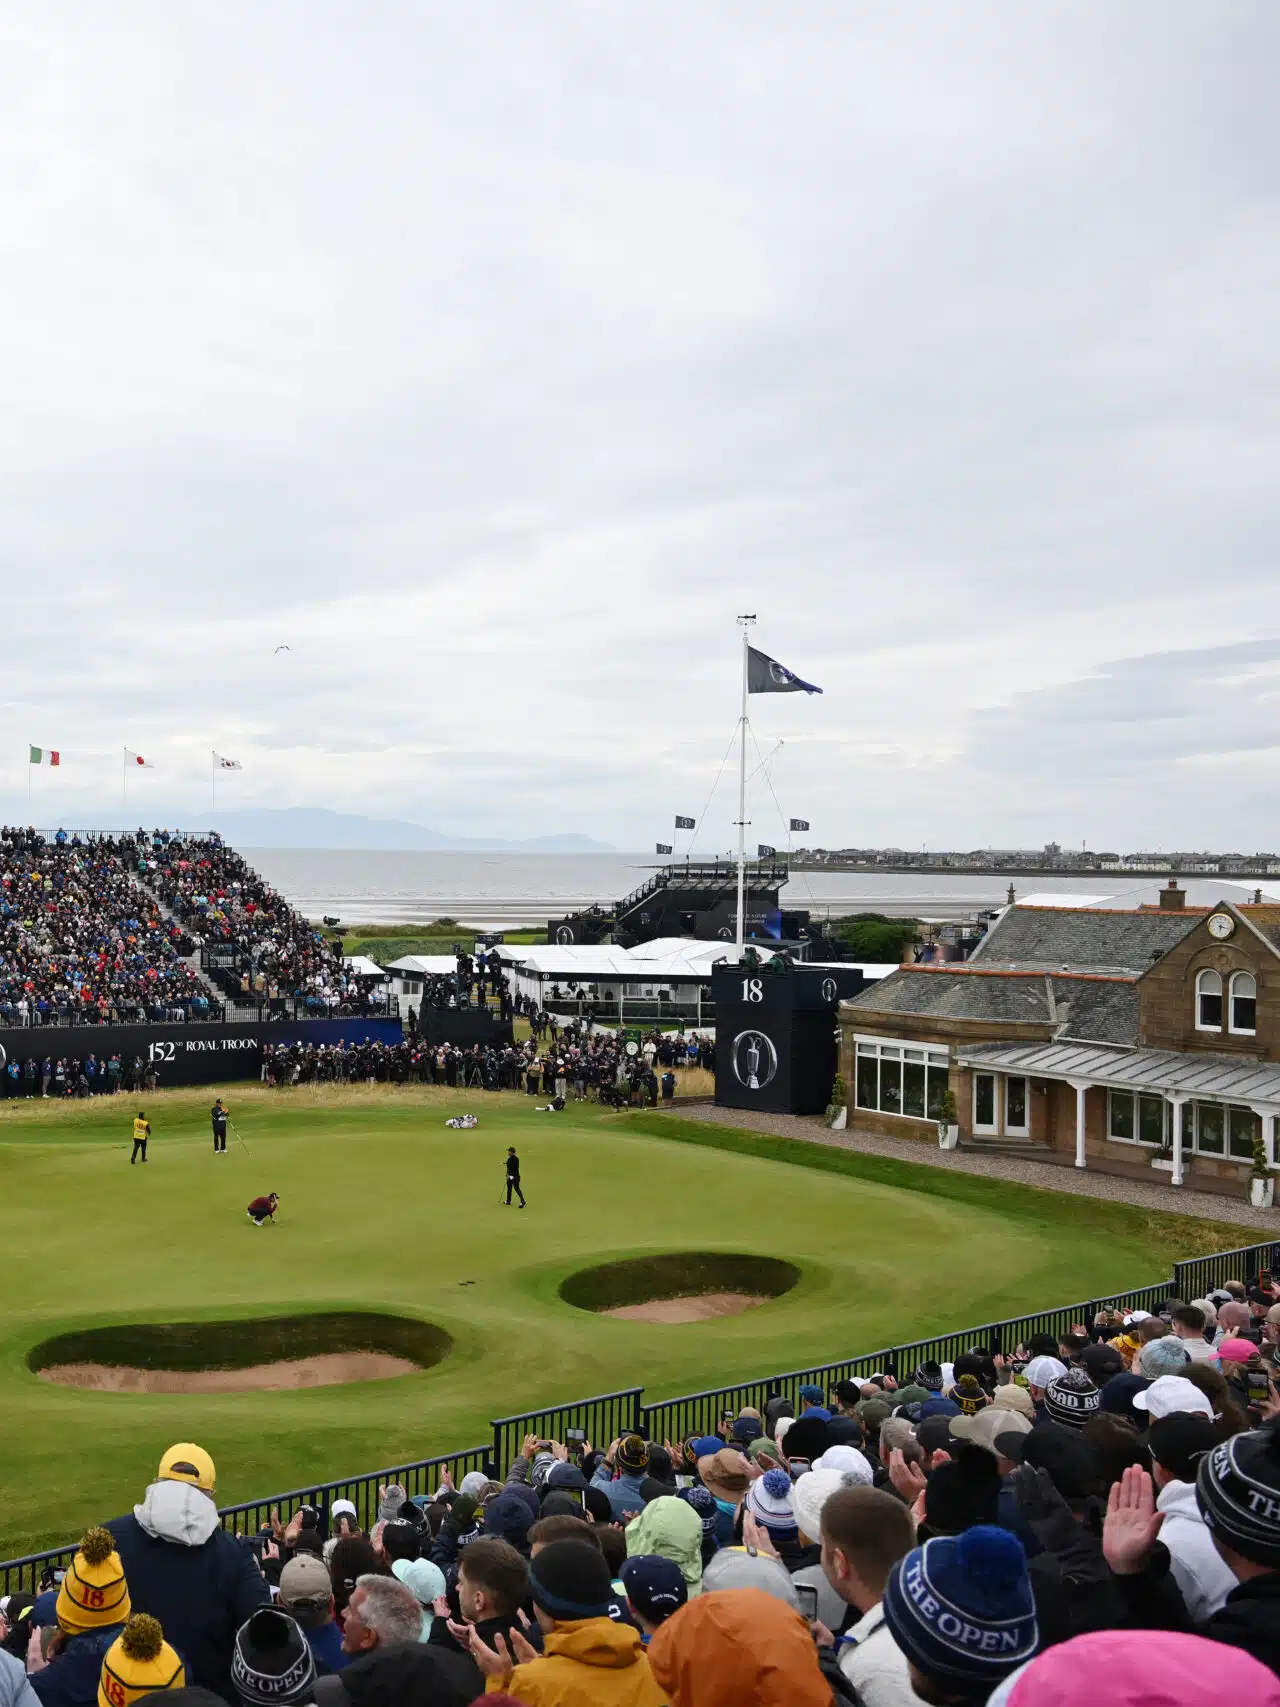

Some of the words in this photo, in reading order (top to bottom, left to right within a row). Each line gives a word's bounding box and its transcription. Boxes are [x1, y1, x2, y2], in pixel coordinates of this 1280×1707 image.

[740, 978, 764, 1003] 18
[186, 1040, 220, 1051] ROYAL
[220, 1038, 258, 1050] TROON
[961, 1400, 977, 1411] 18
[82, 1587, 105, 1607] 18
[907, 1560, 940, 1619] THE
[937, 1613, 1019, 1652] OPEN
[235, 1649, 256, 1688] THE
[258, 1664, 304, 1692] OPEN
[105, 1672, 126, 1707] 18
